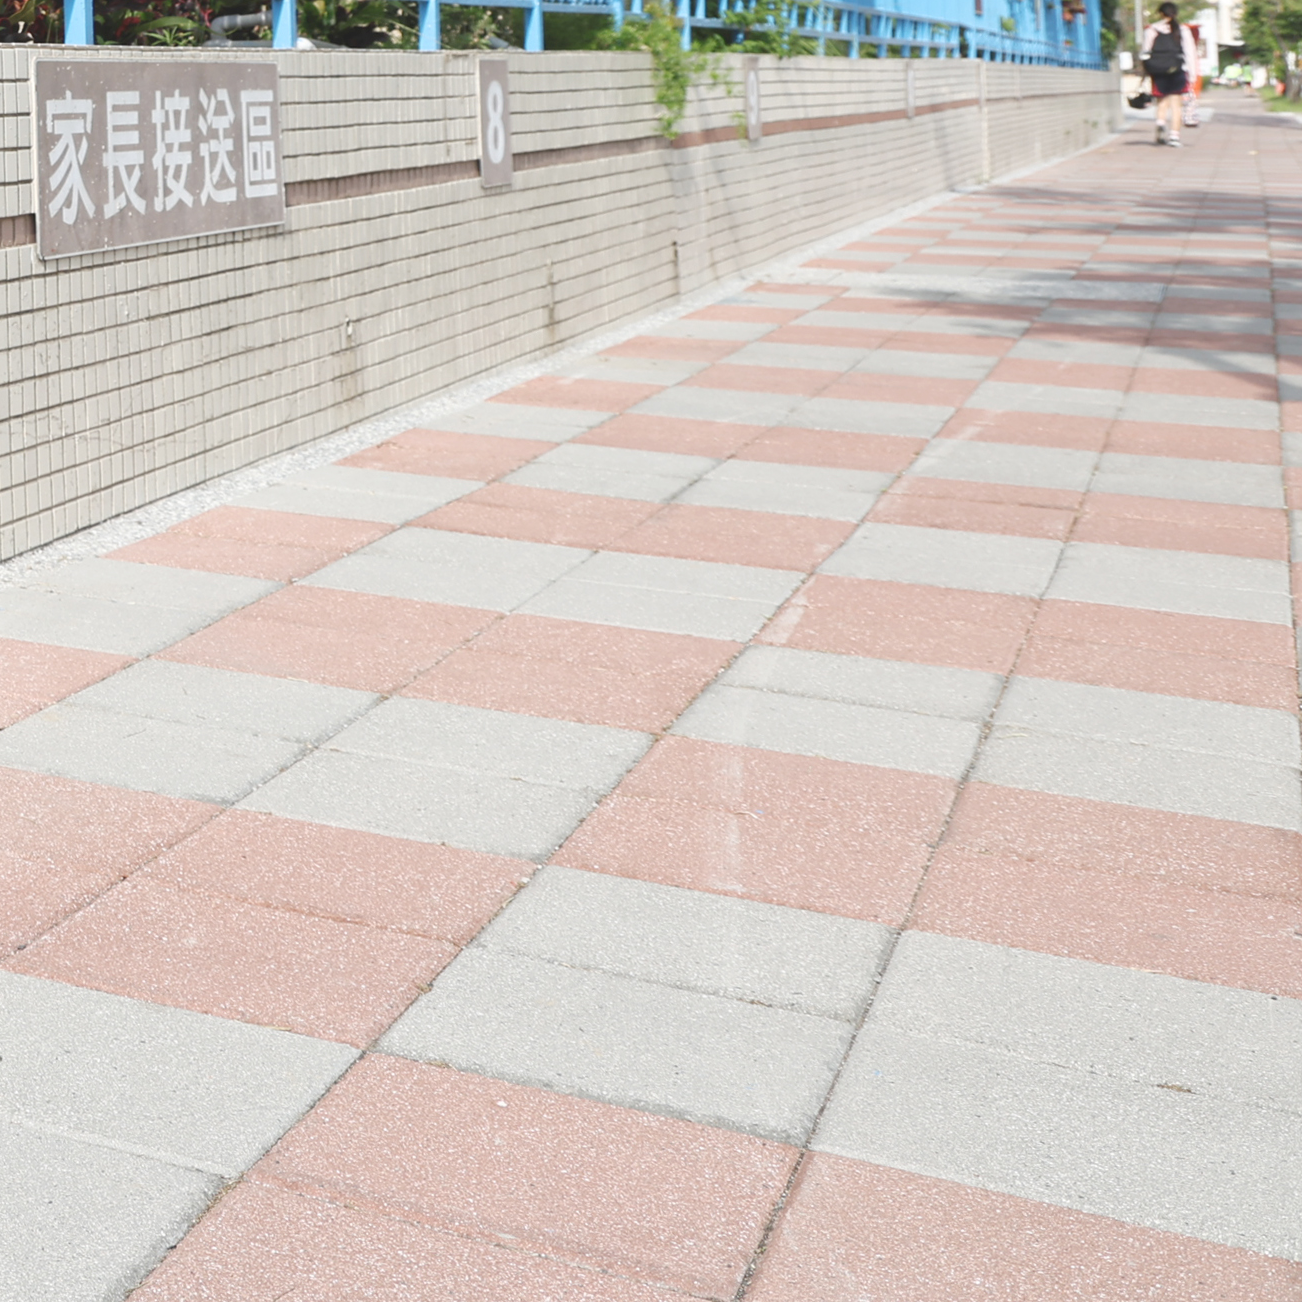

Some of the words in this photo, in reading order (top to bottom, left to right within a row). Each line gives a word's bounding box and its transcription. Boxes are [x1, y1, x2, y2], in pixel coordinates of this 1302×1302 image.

[45, 86, 279, 226] 家長接送區
[485, 79, 505, 165] 8
